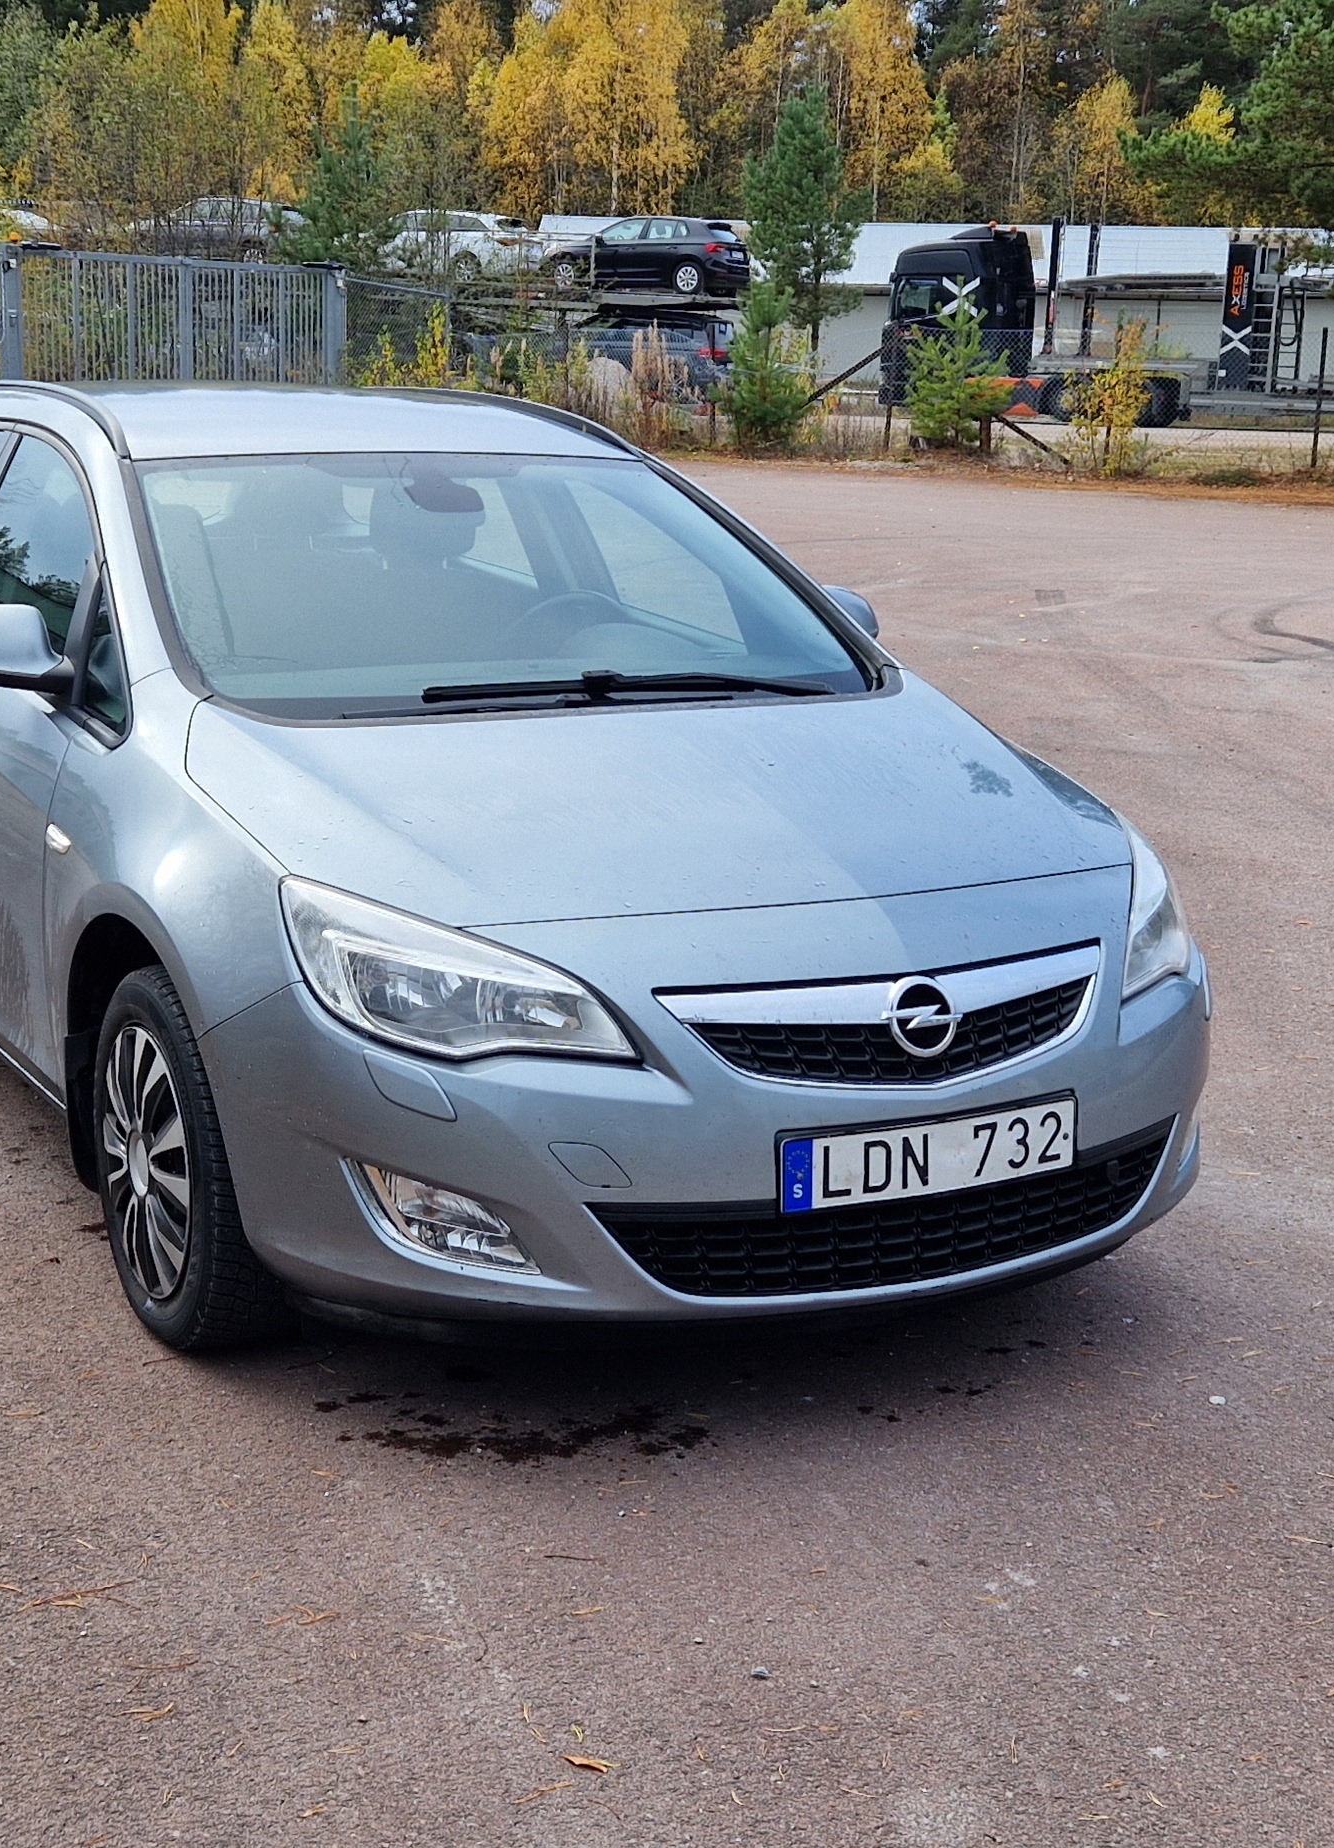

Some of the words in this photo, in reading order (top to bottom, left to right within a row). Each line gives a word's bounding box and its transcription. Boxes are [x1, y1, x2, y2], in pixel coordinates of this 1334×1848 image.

[1230, 264, 1244, 316] AXESS
[822, 1133, 929, 1199] LDN
[973, 1111, 1062, 1177] 732
[793, 1184, 804, 1198] S
